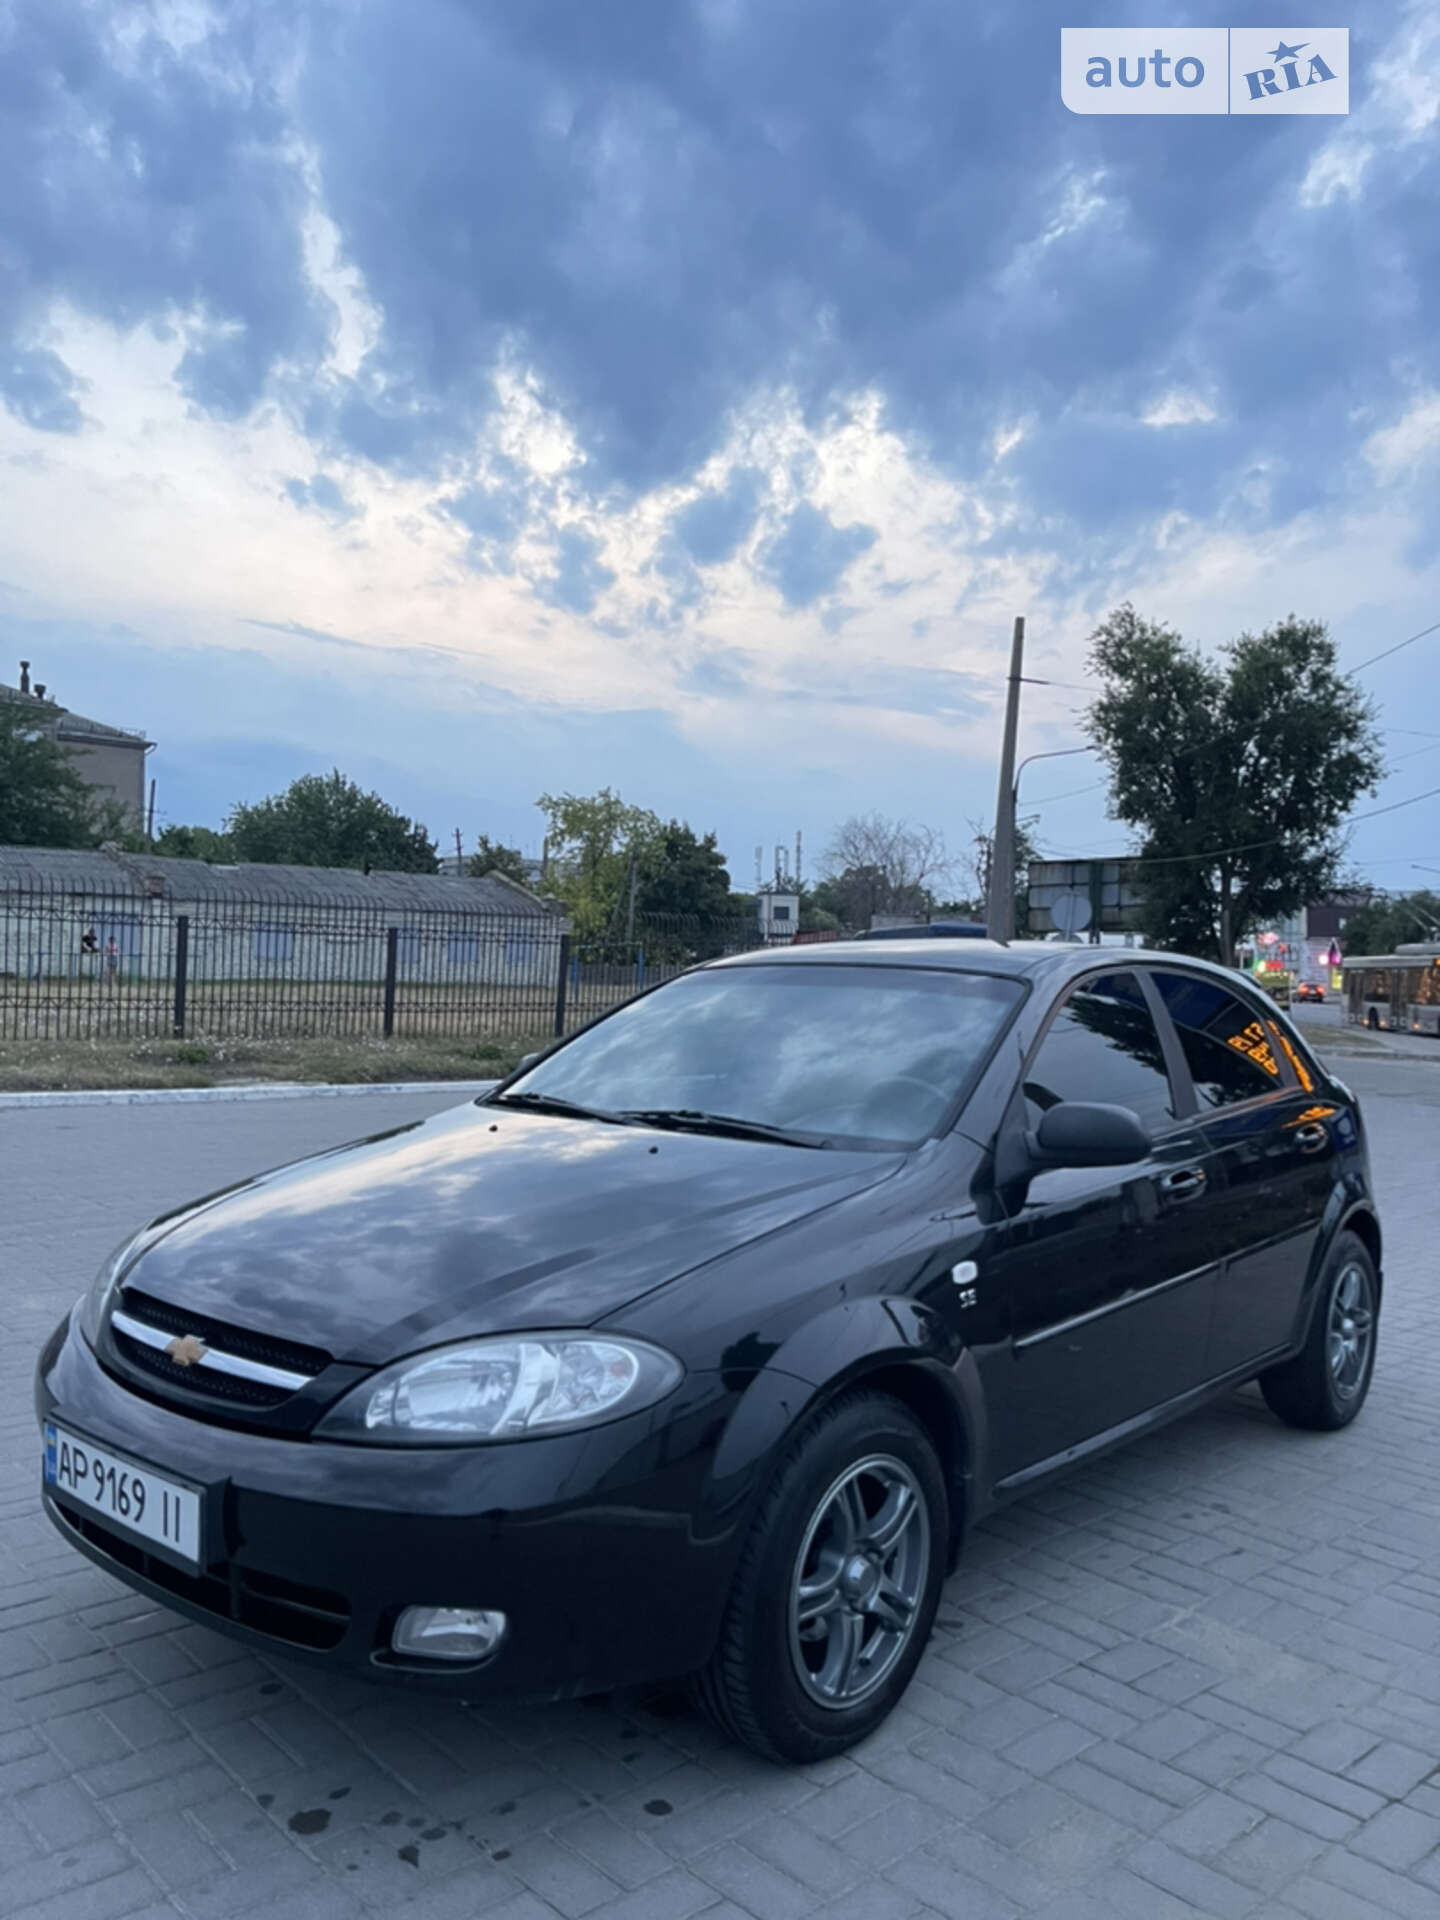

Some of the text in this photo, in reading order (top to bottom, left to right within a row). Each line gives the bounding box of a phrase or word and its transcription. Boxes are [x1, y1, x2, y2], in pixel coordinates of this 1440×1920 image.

[59, 1441, 180, 1543] AP 9169 II
